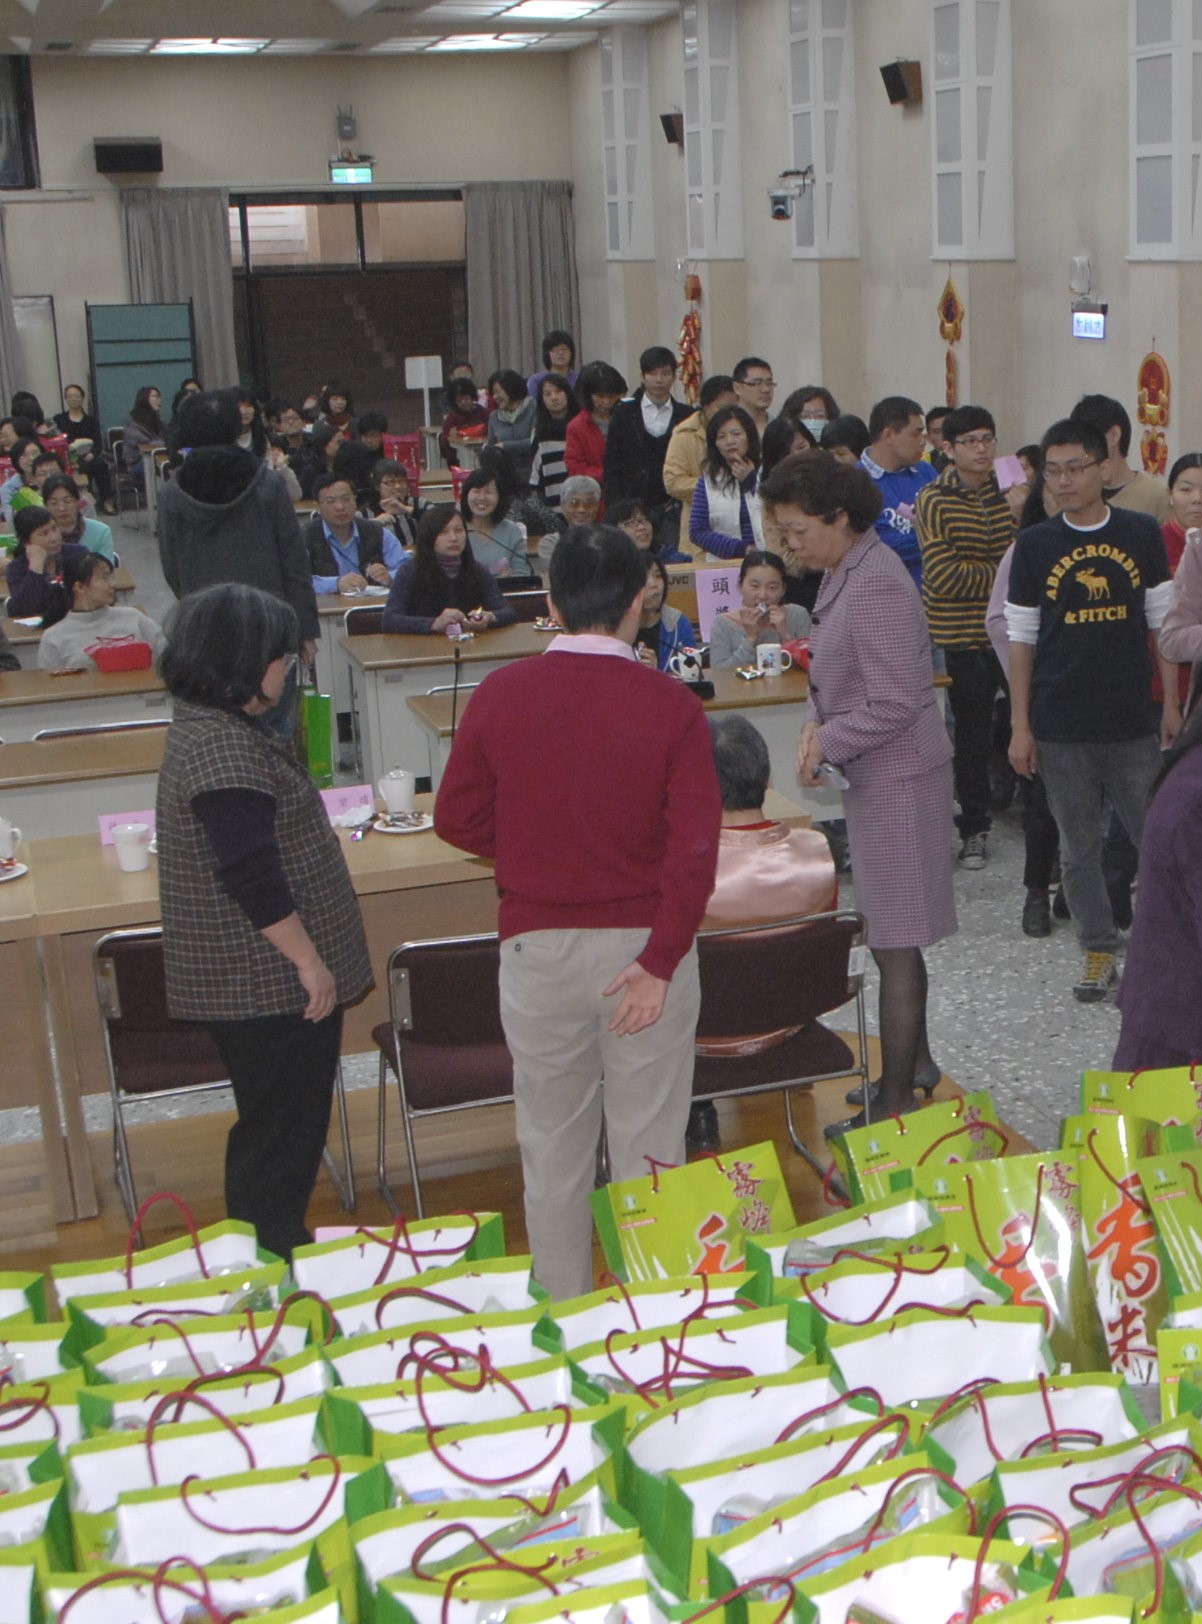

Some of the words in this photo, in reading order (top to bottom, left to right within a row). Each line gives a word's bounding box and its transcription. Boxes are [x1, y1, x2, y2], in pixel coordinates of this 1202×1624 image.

[1046, 544, 1141, 600] ABERCROMBIE
[1064, 612, 1077, 624] &
[1079, 605, 1128, 622] FITCH
